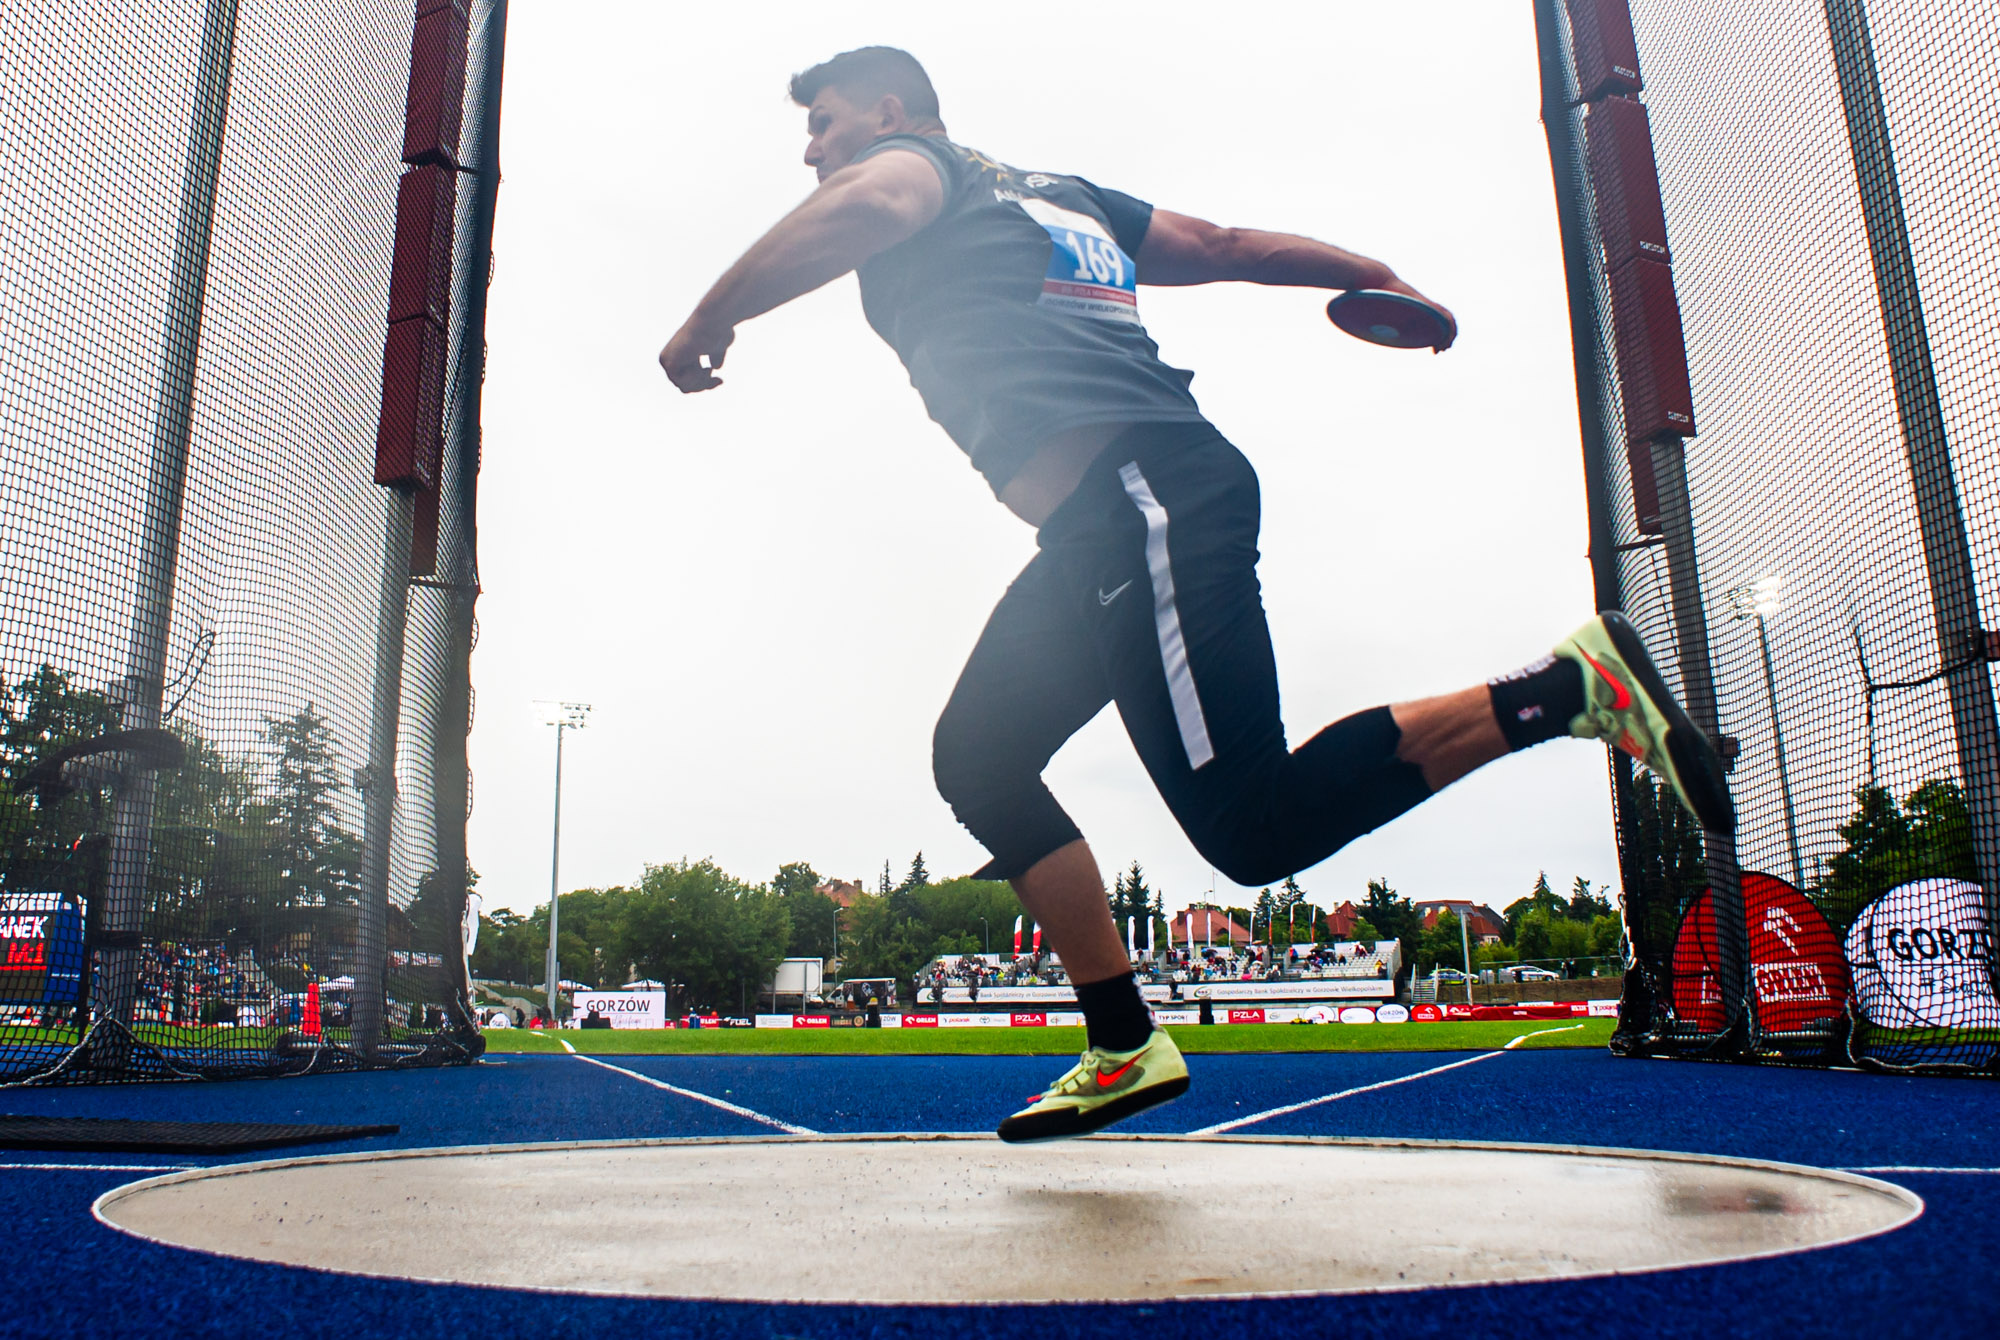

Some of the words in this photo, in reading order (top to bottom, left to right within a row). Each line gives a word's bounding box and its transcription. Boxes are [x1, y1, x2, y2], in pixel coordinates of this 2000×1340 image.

[1066, 231, 1124, 287] 169
[586, 996, 651, 1012] GORZÓW
[1014, 1014, 1042, 1022] PZLA
[1232, 1010, 1261, 1019] PZLA
[915, 1016, 937, 1024] ORLEN
